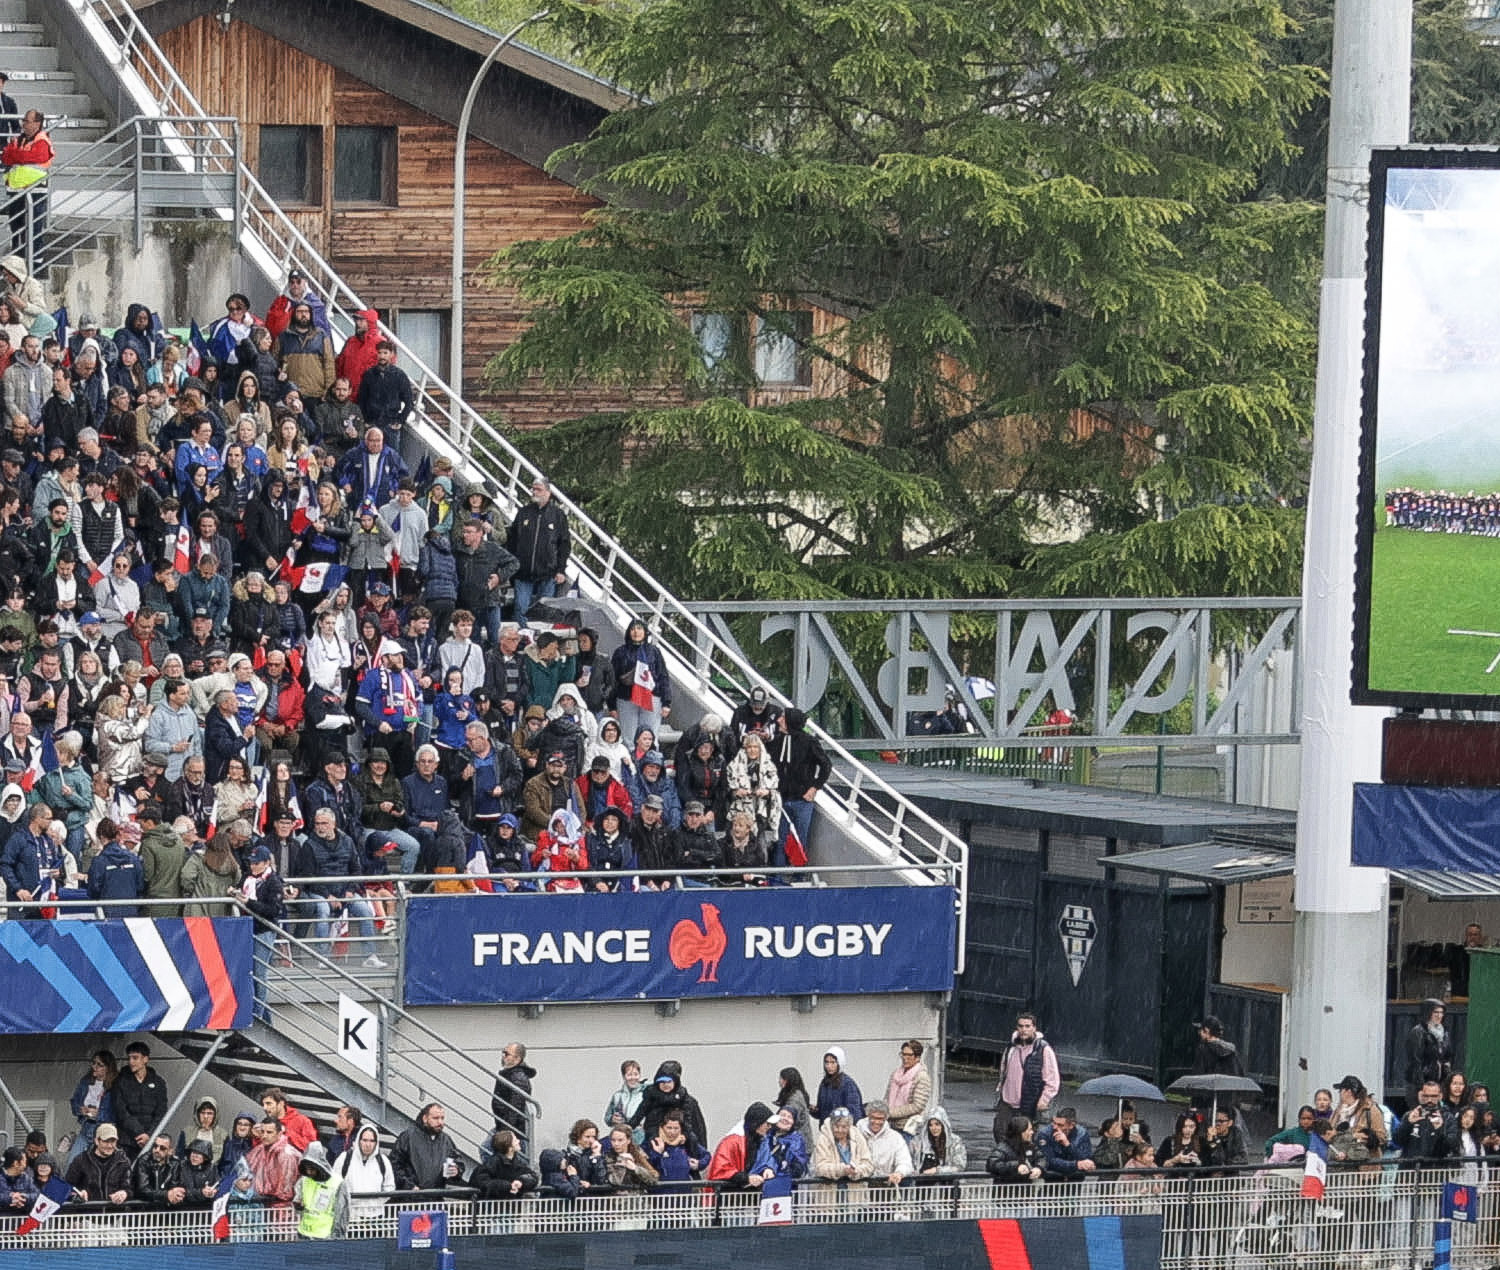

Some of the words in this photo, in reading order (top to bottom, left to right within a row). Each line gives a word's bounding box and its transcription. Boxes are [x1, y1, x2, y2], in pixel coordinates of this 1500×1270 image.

[473, 930, 651, 966] FRANCE
[744, 922, 892, 959] RUGBY
[343, 1018, 368, 1050] K
